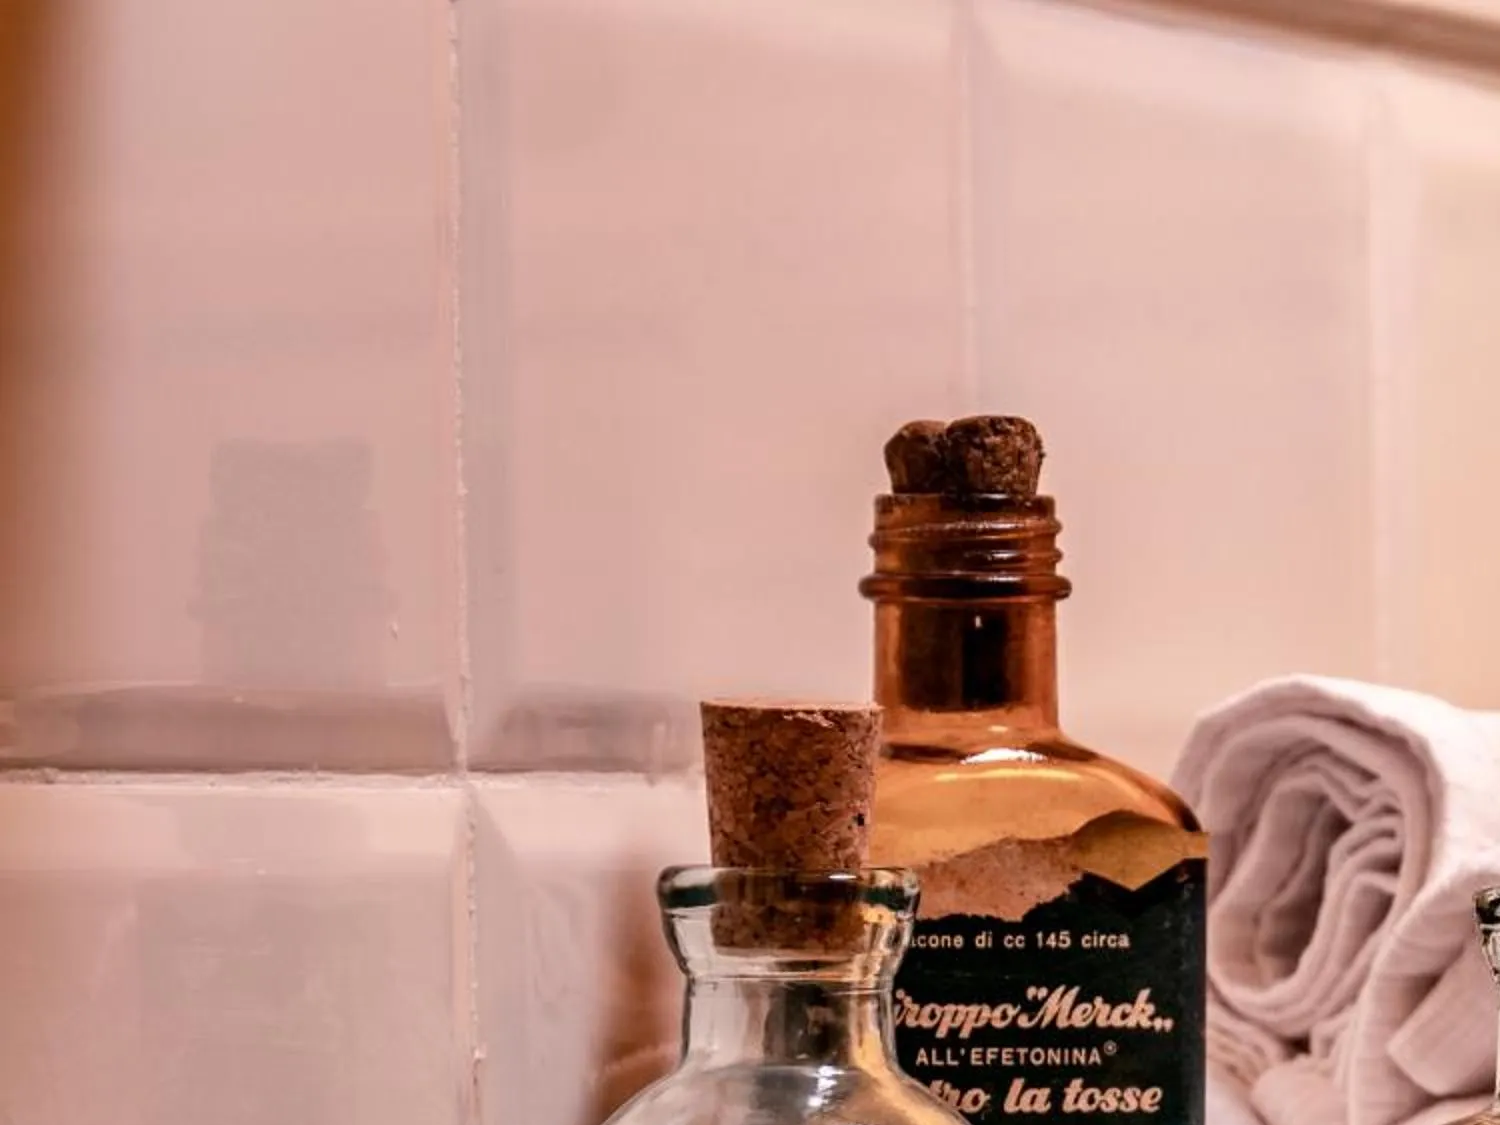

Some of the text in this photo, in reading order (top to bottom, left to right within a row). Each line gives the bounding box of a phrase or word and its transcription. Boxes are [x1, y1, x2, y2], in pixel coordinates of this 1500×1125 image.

[975, 930, 993, 948] di
[1003, 933, 1025, 948] cc
[1036, 931, 1072, 948] 145
[1081, 930, 1130, 948] circa
[1003, 1077, 1052, 1113] la
[1061, 1077, 1163, 1113] tosse
